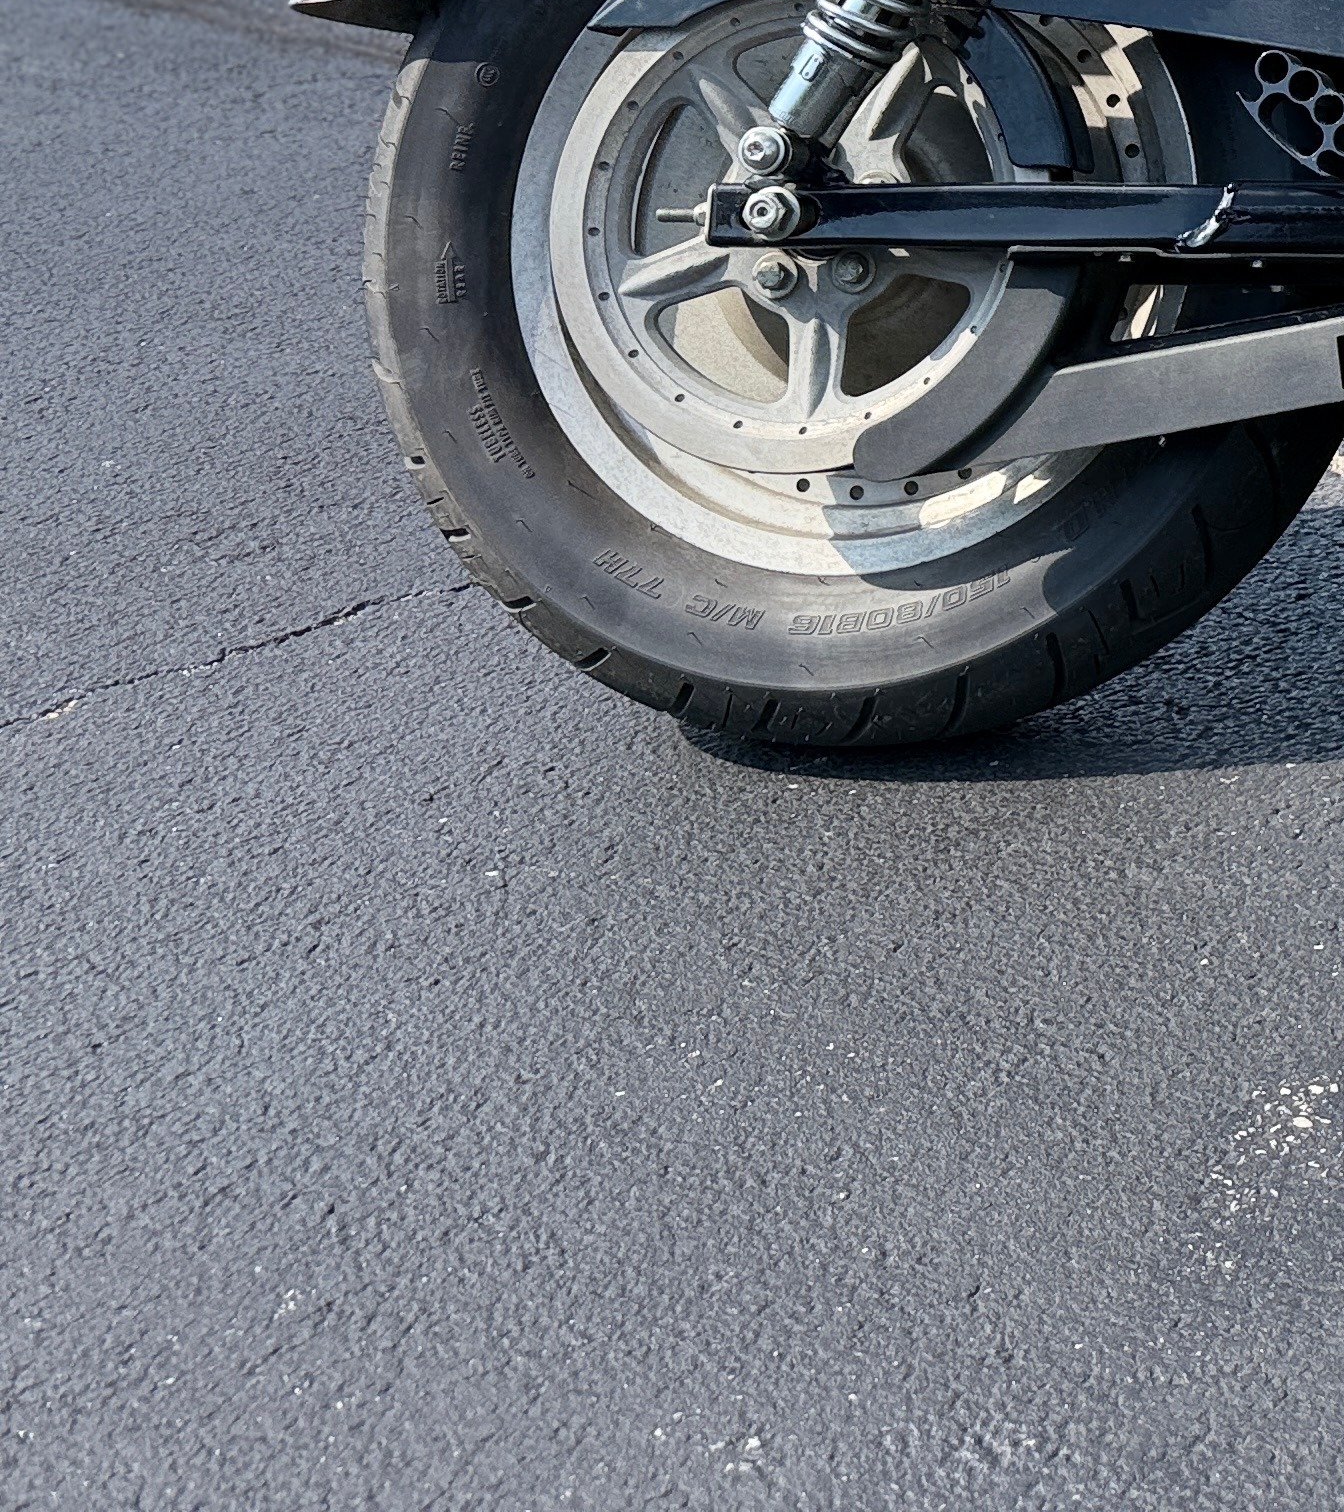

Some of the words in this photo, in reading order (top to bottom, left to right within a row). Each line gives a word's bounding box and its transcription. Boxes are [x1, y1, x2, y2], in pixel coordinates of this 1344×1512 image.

[434, 261, 448, 304] ROTATION
[454, 265, 467, 297] REAR
[467, 403, 506, 463] TUBELESS
[593, 550, 664, 600] 77H
[685, 595, 766, 630] M/C
[788, 569, 1011, 635] 150/80B16
